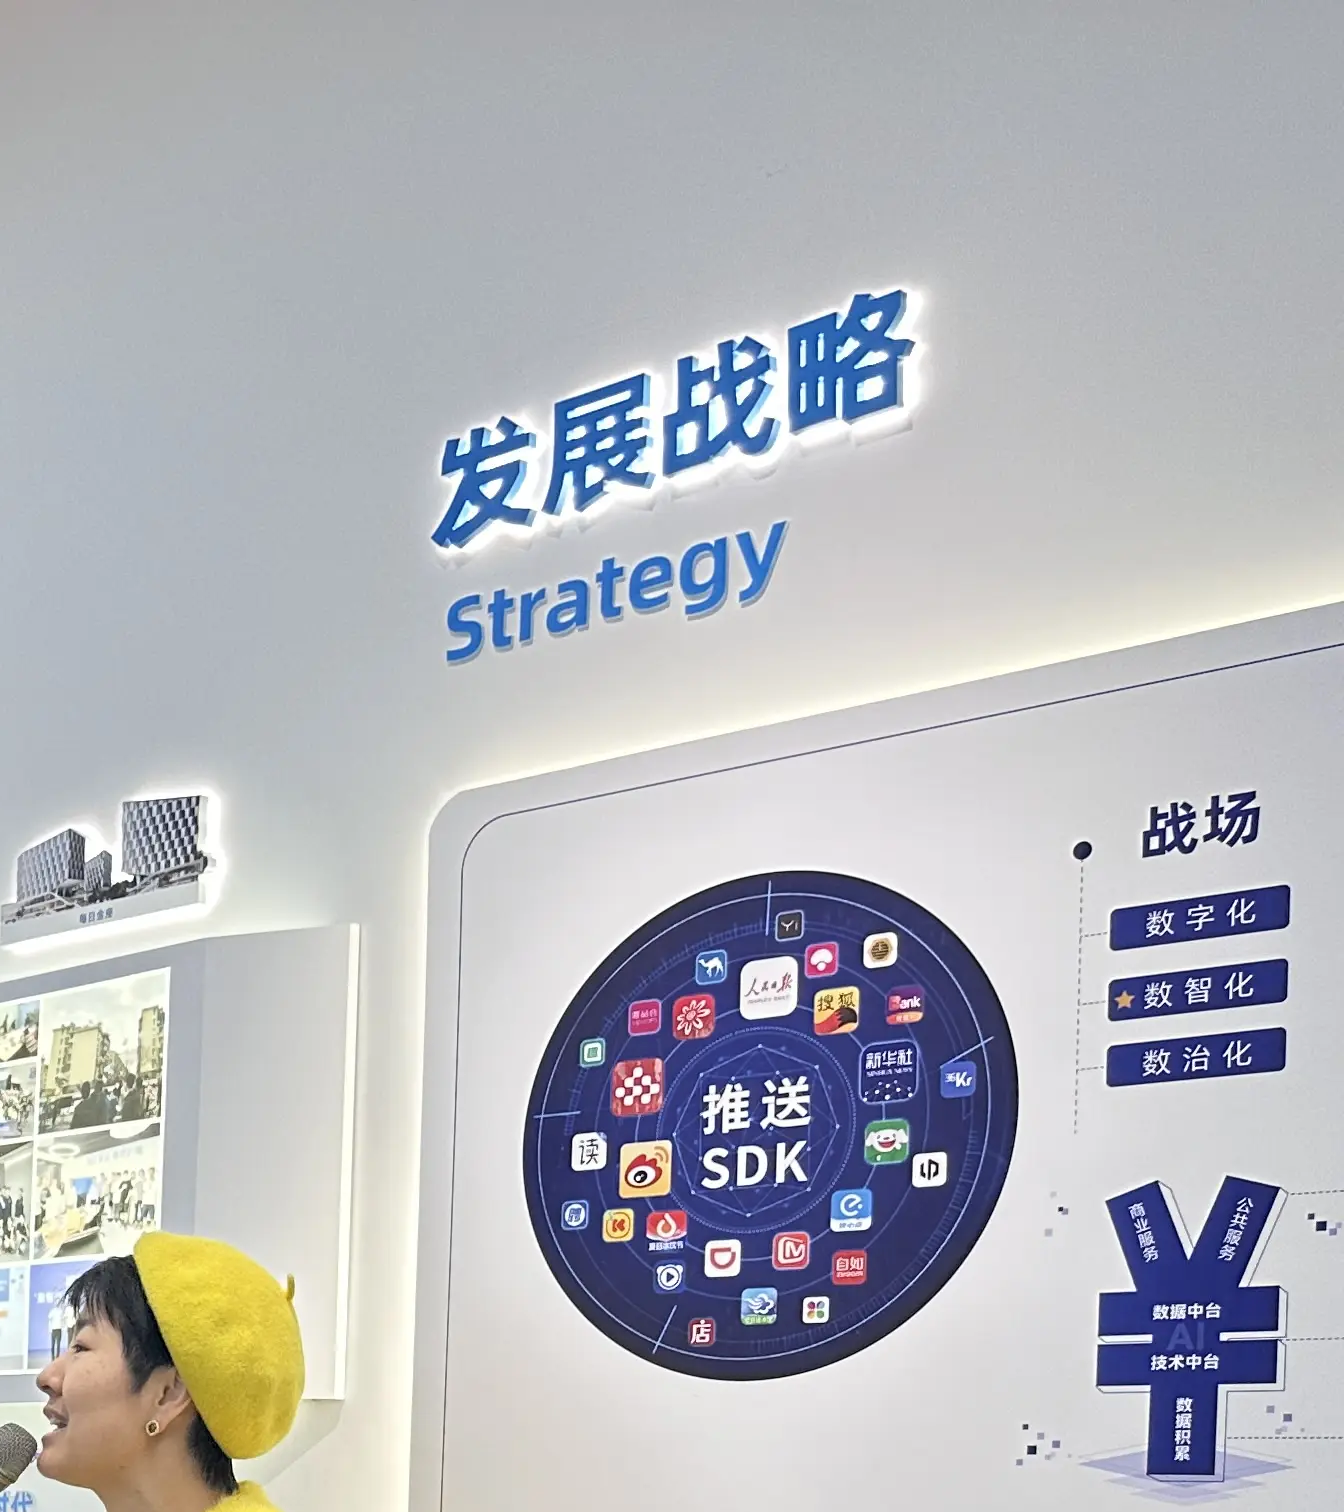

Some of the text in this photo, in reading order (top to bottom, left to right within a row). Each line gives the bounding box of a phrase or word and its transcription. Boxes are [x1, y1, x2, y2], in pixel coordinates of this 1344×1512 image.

[431, 289, 916, 549] 发展战略
[445, 520, 790, 665] Strategy
[1141, 791, 1261, 858] 战场
[1145, 899, 1256, 938] 数字化
[816, 992, 857, 1012] 搜狐
[1144, 972, 1254, 1010] 数智化
[865, 1048, 913, 1069] 新华社
[1142, 1041, 1252, 1077] 数治化
[700, 1076, 811, 1135] 推送
[578, 1138, 600, 1166] 读
[701, 1140, 808, 1189] SDK
[1127, 1202, 1160, 1262] 商业服务
[1217, 1197, 1254, 1261] 公共服务
[836, 1257, 864, 1273] 自如
[1152, 1303, 1222, 1320] 数据中台
[690, 1319, 712, 1344] 店
[1150, 1354, 1220, 1371] 技术中台
[1174, 1397, 1192, 1461] 数据积累
